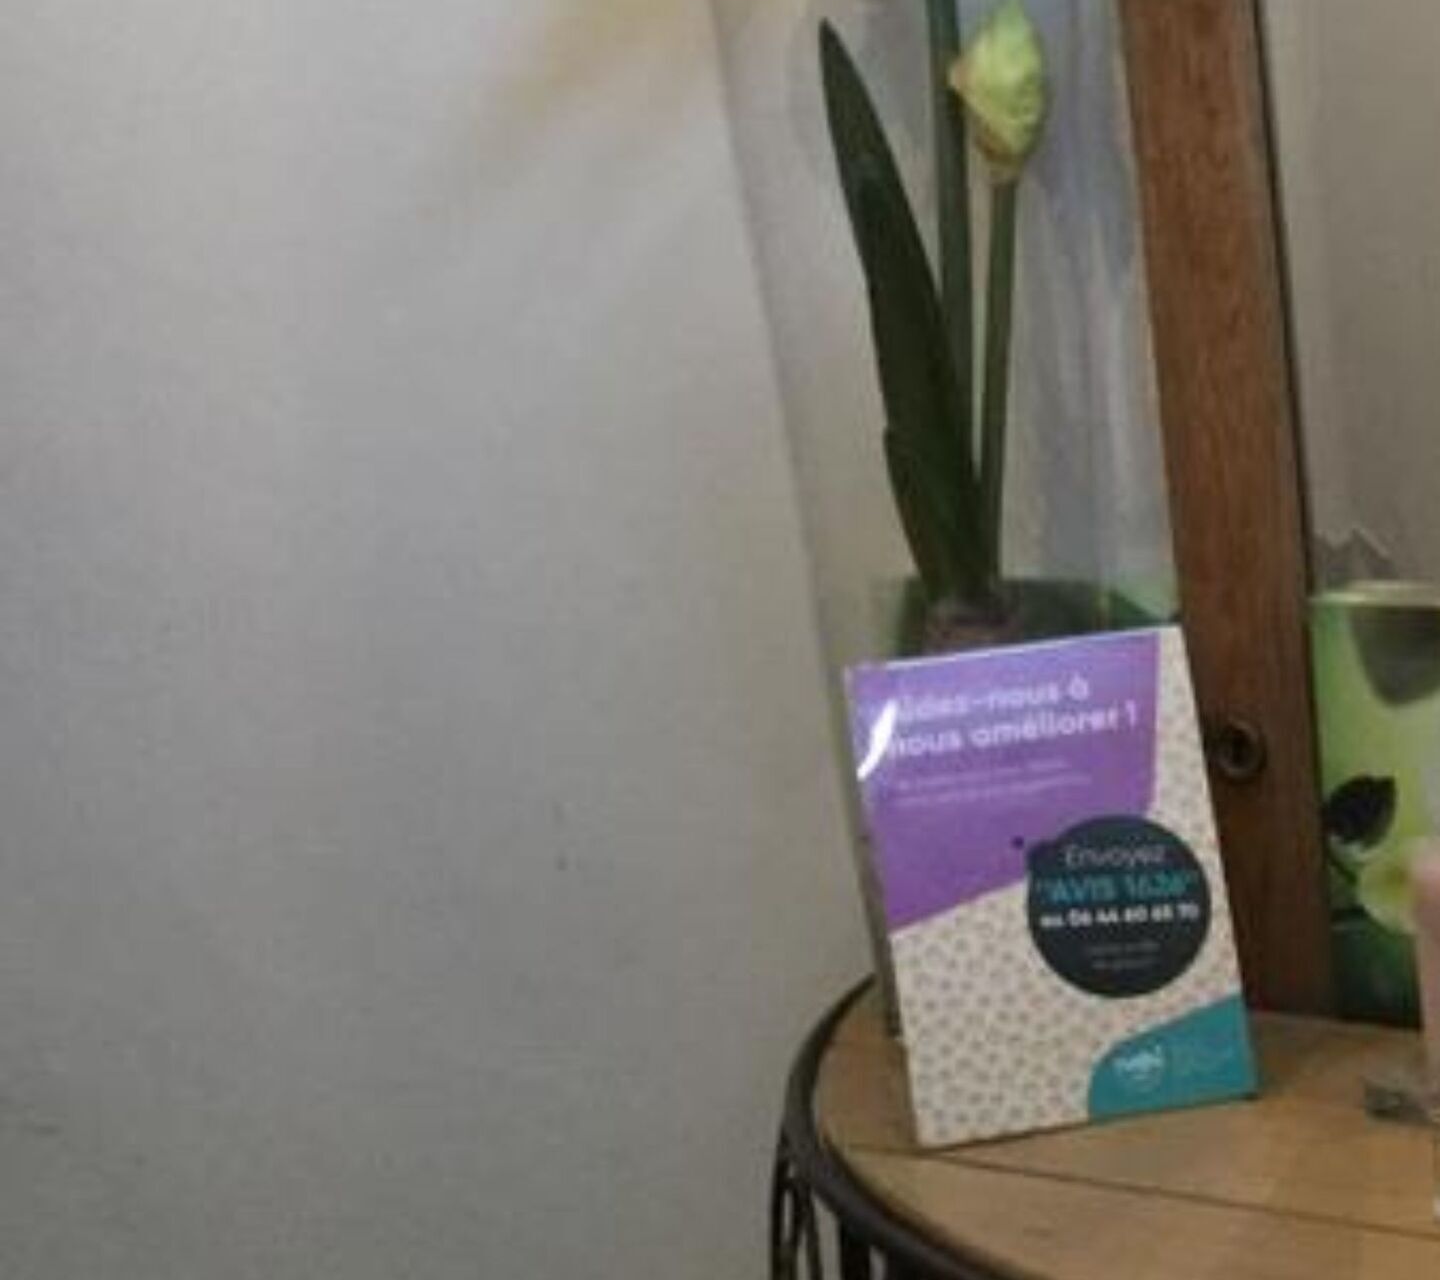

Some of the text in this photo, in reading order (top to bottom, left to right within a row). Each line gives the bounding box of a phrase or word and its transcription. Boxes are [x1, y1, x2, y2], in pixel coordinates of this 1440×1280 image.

[882, 681, 1061, 723] idez-nous
[886, 729, 964, 760] nous
[970, 703, 1120, 748] améliorer
[1065, 842, 1167, 868] Envoyez
